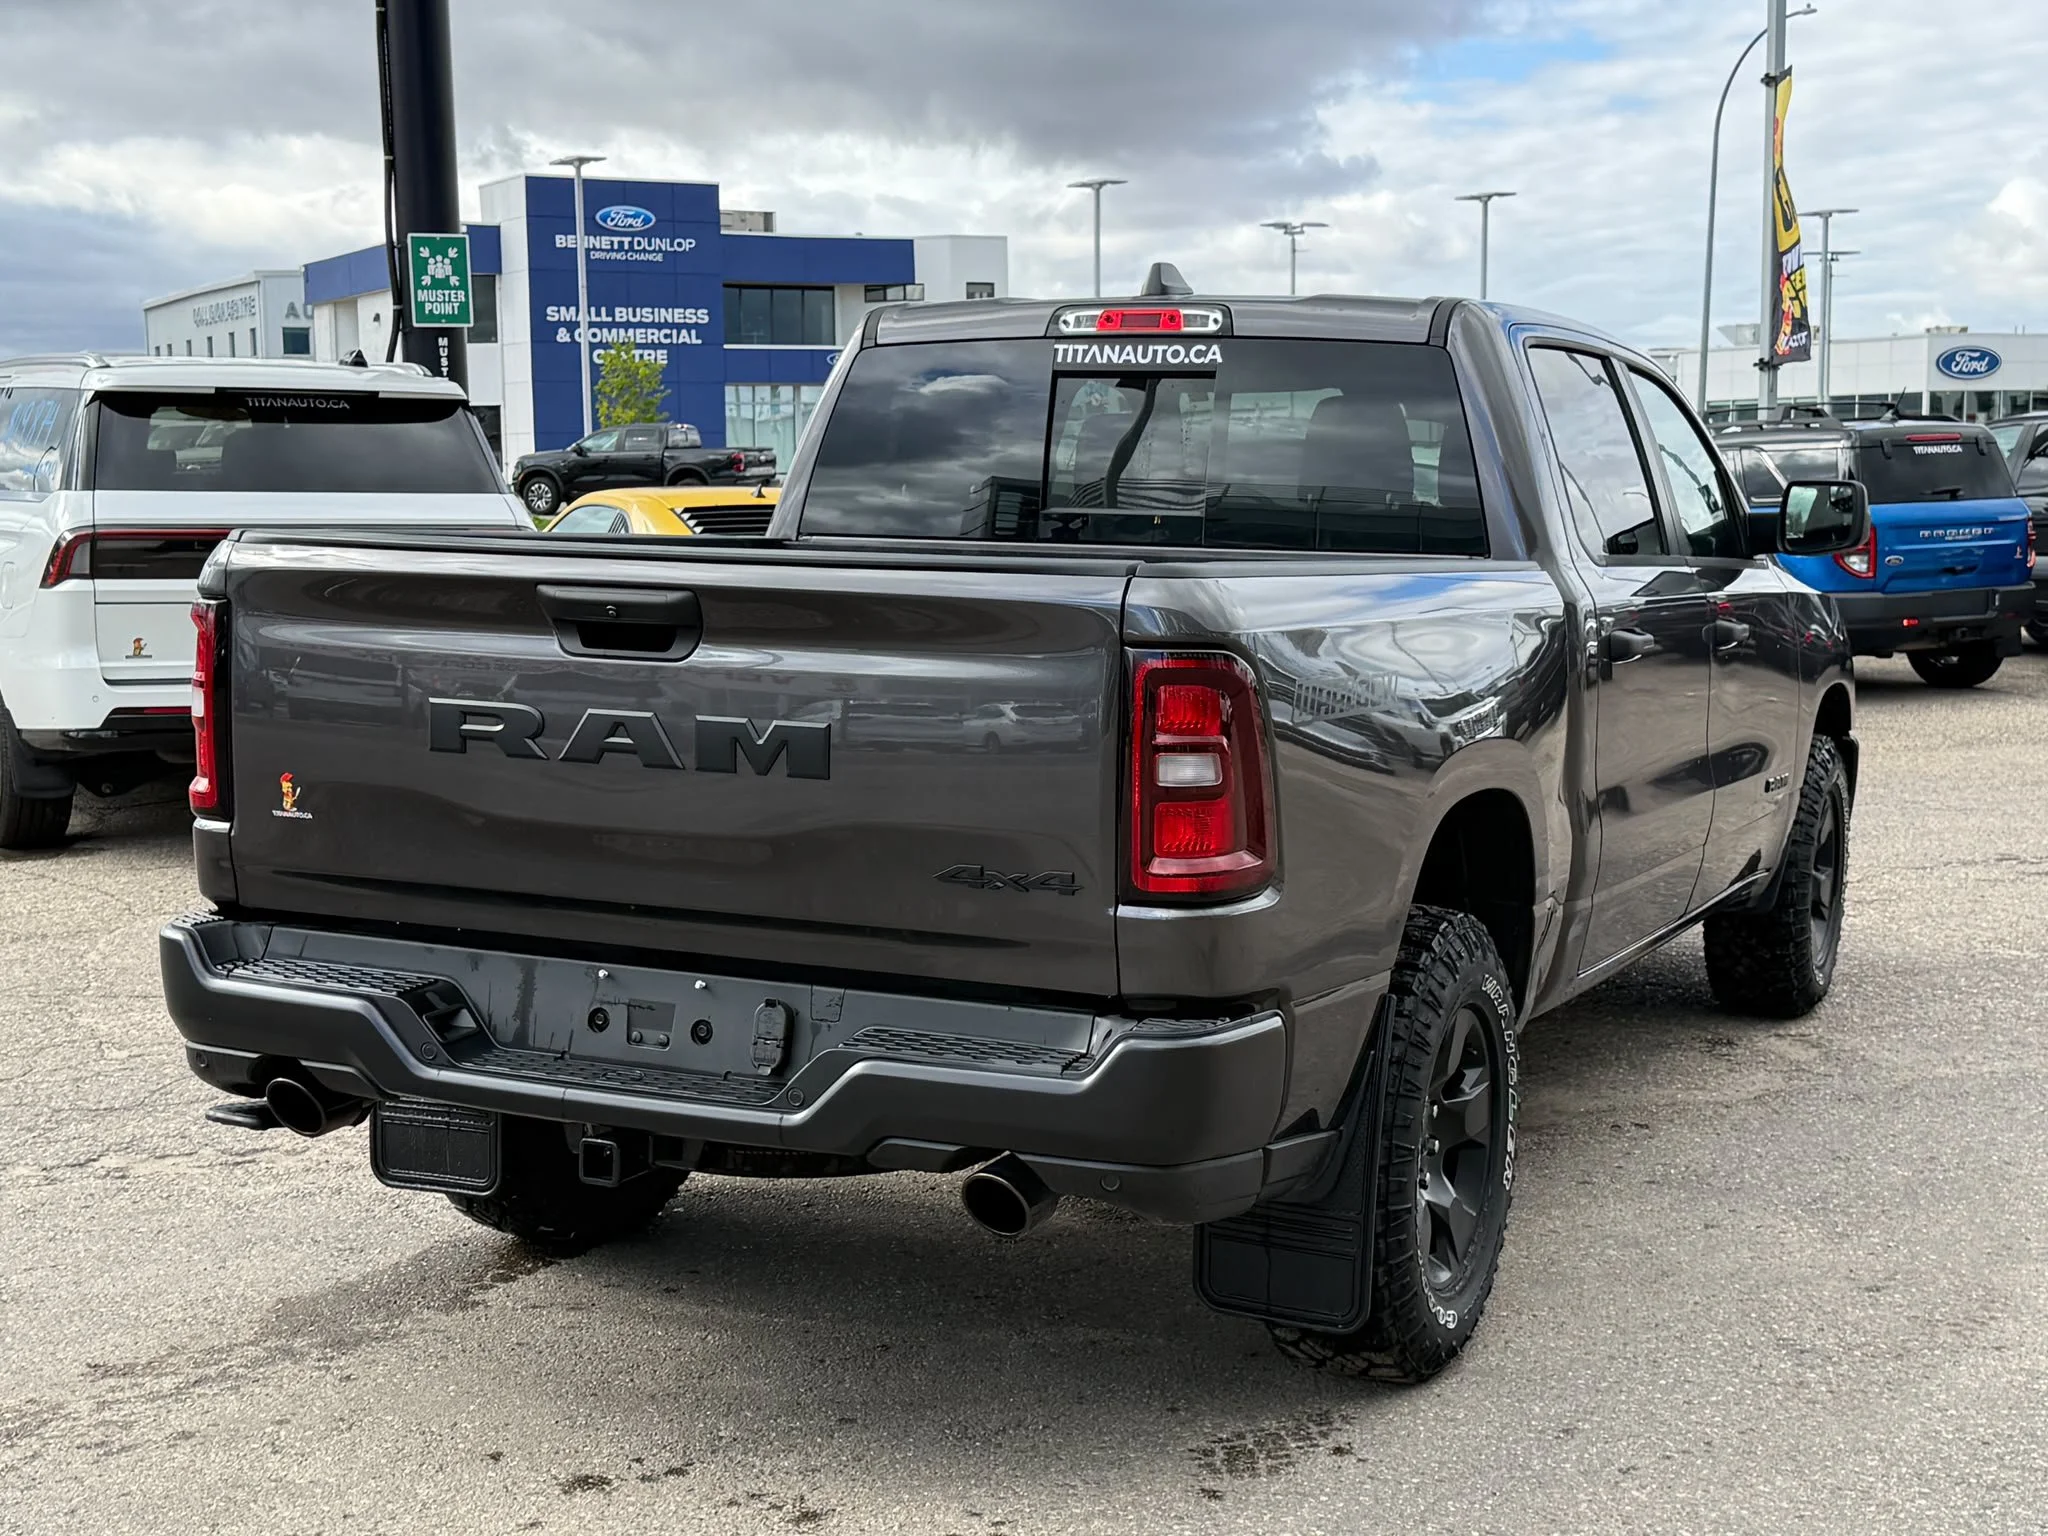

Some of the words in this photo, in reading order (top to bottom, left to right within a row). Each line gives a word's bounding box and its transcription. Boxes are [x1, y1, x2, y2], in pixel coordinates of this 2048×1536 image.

[633, 236, 696, 252] DUNLOP
[590, 251, 626, 261] DRIVING
[627, 252, 664, 262] CHANGE
[417, 289, 465, 302] MUSTER
[424, 302, 460, 315] POINT
[614, 306, 710, 324] BUSINESS
[556, 327, 572, 343] &
[592, 349, 668, 365] CTRE
[1054, 344, 1223, 364] TITANAUTO.CA
[246, 398, 350, 410] TITANAUTO.CA
[428, 696, 832, 781] RAM
